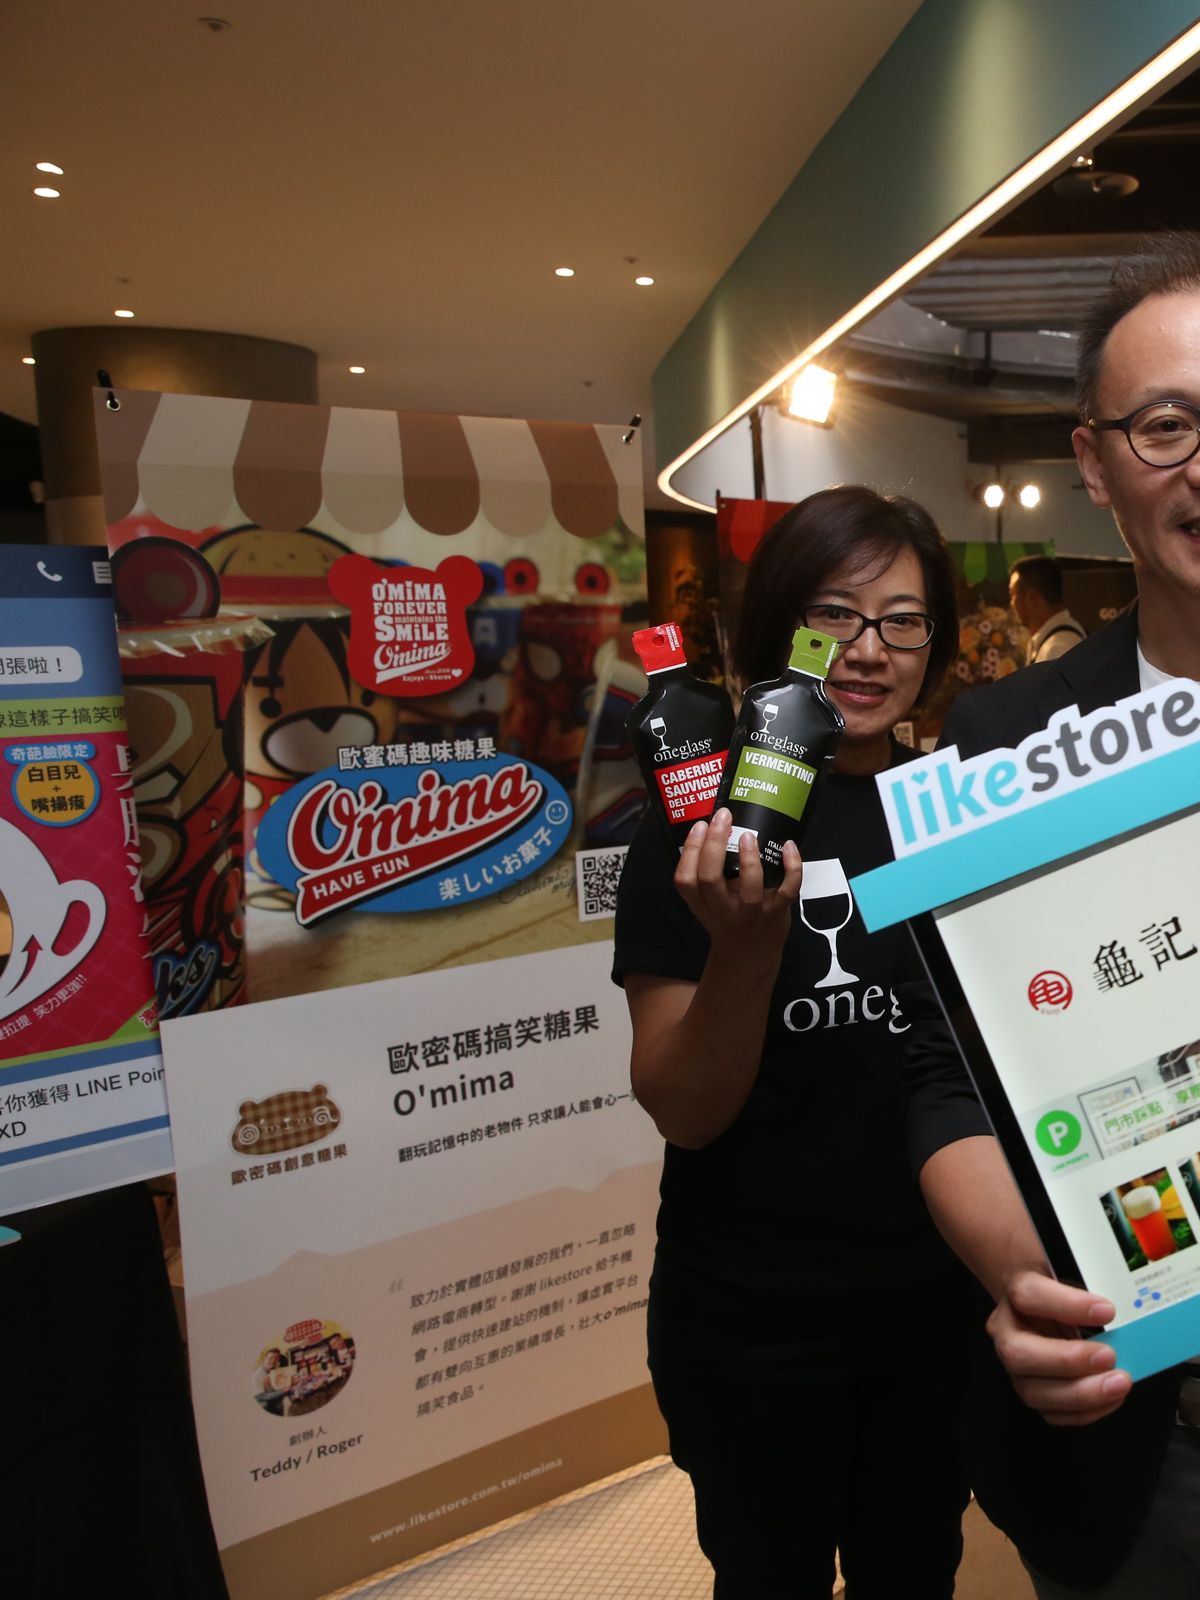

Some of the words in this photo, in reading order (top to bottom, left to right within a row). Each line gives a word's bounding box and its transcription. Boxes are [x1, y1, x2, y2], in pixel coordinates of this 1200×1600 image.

[373, 601, 447, 615] FOREVER
[0, 657, 63, 676] 張啦！
[373, 642, 451, 671] O'mima
[338, 737, 497, 771] 歐蜜碼趣味糖果
[745, 751, 815, 785] VERMENTINO
[28, 764, 81, 783] 白目兒
[661, 758, 723, 785] CABERNET
[738, 776, 779, 795] TOSCANA
[668, 794, 697, 809] DELLE
[734, 787, 750, 798] IGT
[287, 762, 543, 871] O'mima
[671, 808, 686, 819] IGT
[312, 871, 366, 900] HAVE
[372, 855, 411, 880] FUN
[438, 825, 554, 901] 楽しいお菓子
[387, 1004, 600, 1075] 歐密碼搞笑糖果
[0, 1084, 71, 1116] 你獲得
[76, 1075, 123, 1098] LINE
[393, 1070, 515, 1117] O'mima
[398, 1117, 525, 1164] 翻玩記憶中的老物件
[539, 1265, 593, 1291] likestore
[250, 1456, 302, 1482] Teddy
[317, 1433, 364, 1459] Roger
[369, 1457, 564, 1544] www.likestore.com.tw/omima
